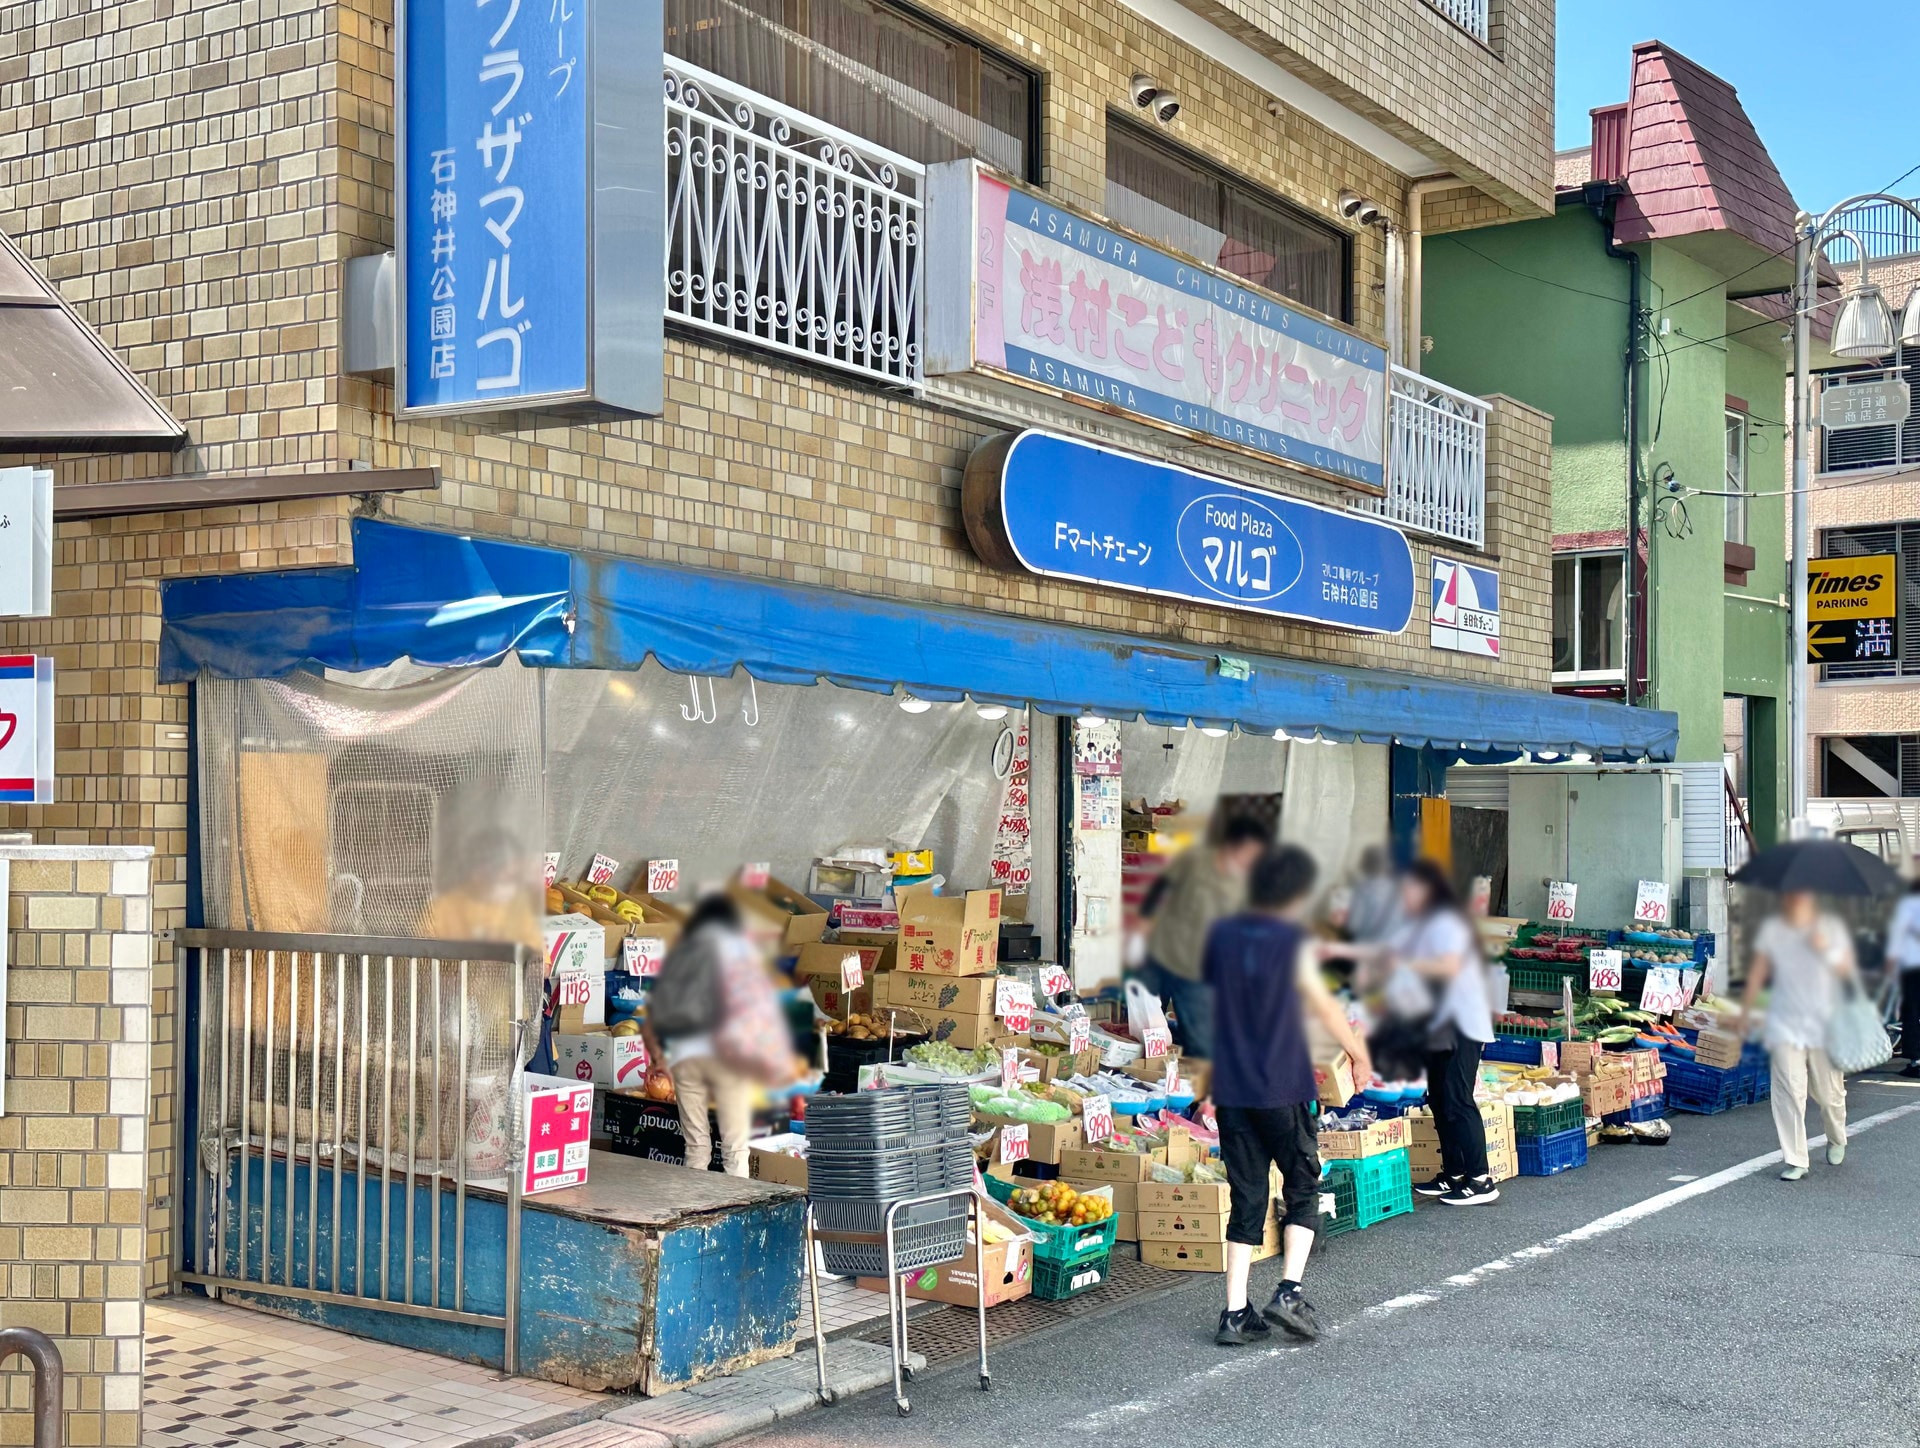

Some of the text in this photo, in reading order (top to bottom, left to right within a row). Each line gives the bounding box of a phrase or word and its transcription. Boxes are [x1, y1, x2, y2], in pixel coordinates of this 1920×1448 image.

[430, 147, 457, 380] 石神井公園店
[980, 226, 995, 319] 2F
[1029, 206, 1370, 364] ASAMURA CHILDRENS CLINIC
[1020, 249, 1369, 442] 浅村こどもクリニック
[1829, 395, 1901, 411] 二丁目通り
[1845, 408, 1887, 423] 商店会
[1029, 357, 1369, 480] ASAMURA CHILDREN'S CLINIC
[1205, 503, 1273, 538] Food Plaza
[1055, 521, 1152, 566] Fマートチェーン
[1203, 536, 1277, 592] マルゴ
[1322, 581, 1379, 609] 石神井公園店
[1808, 572, 1883, 595] Times
[1816, 597, 1868, 609] PARKING
[1855, 619, 1892, 657] 満
[1549, 900, 1573, 918] 480
[1637, 900, 1666, 919] 380
[910, 953, 924, 971] 梨
[565, 980, 590, 1005] 178
[1089, 1113, 1112, 1141] 980
